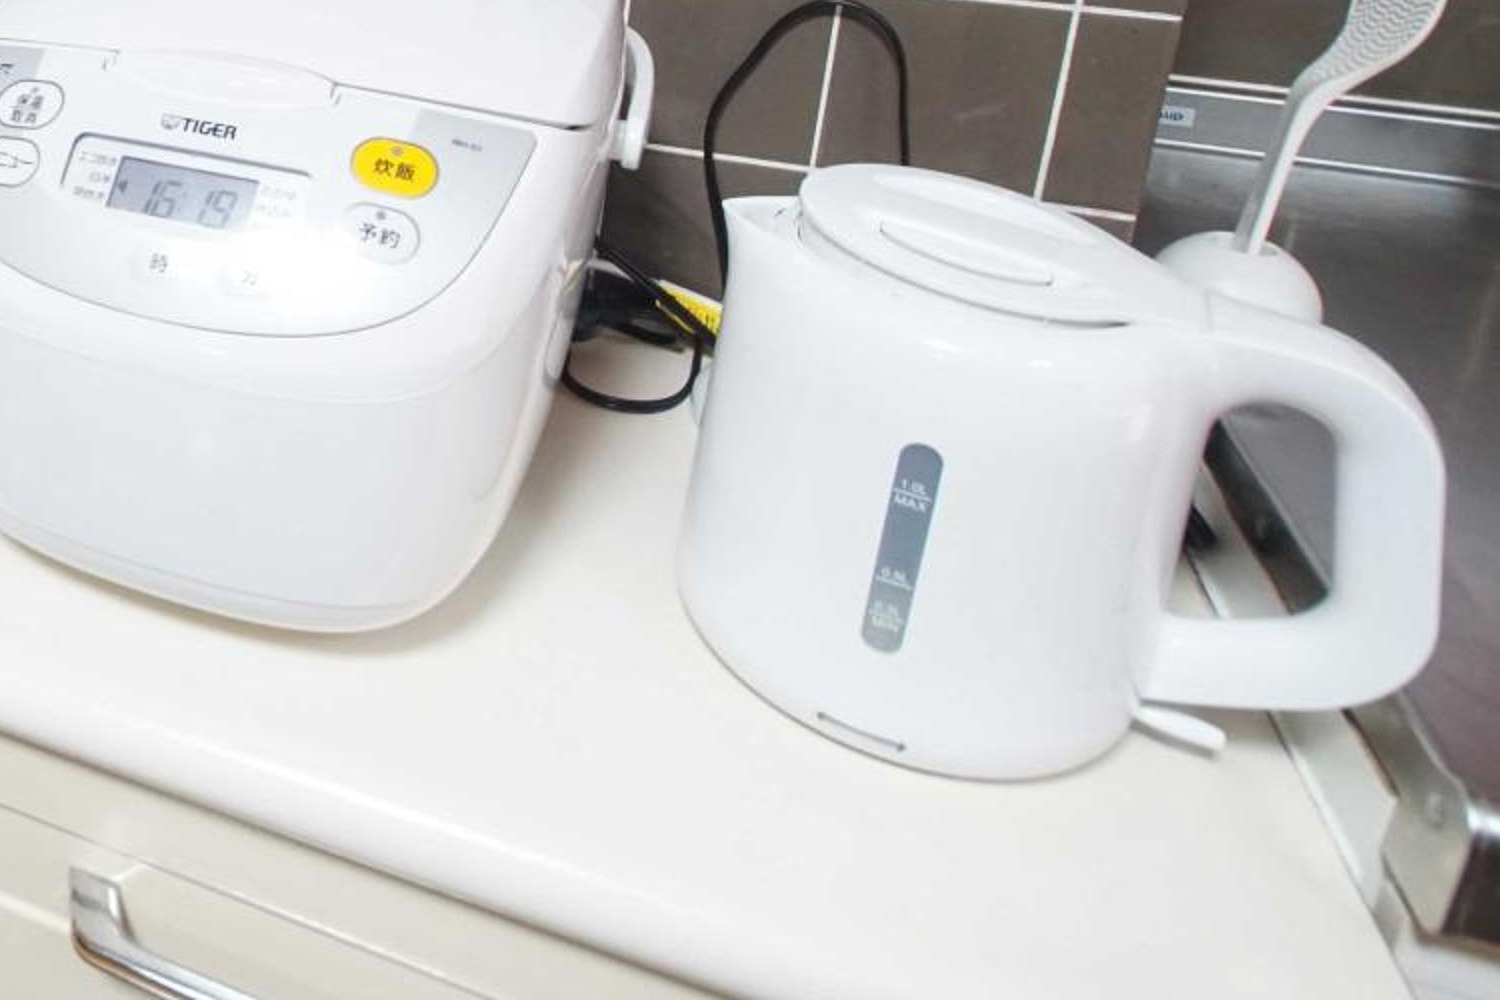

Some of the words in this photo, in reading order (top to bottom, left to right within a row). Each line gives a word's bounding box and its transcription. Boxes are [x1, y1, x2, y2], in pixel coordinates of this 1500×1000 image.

[182, 117, 238, 140] TIGER
[373, 158, 415, 181] 炊飯
[359, 223, 401, 249] 予約
